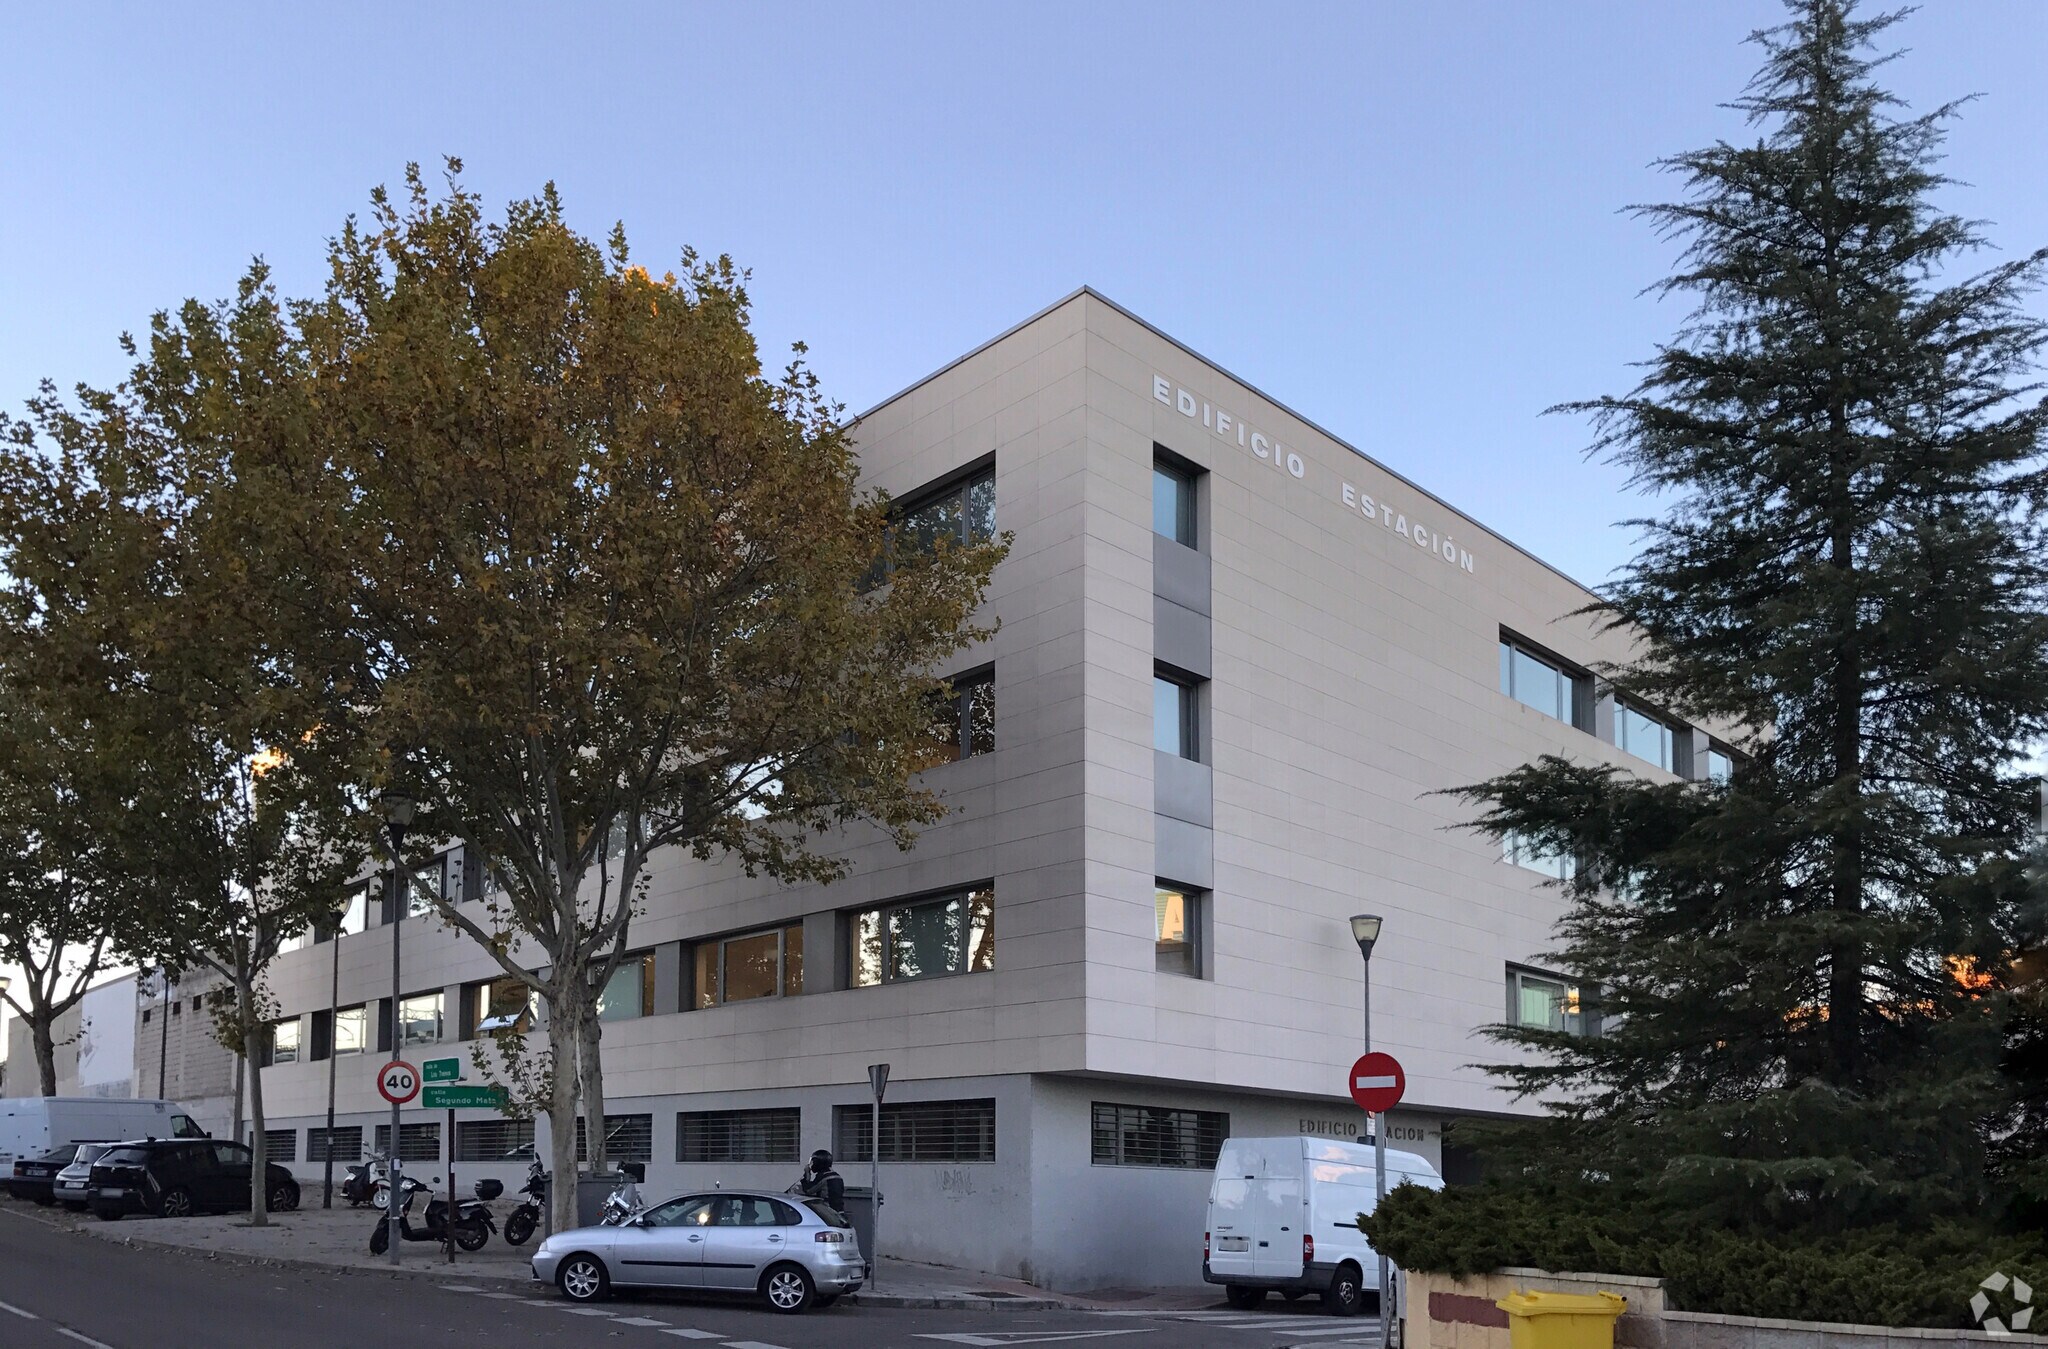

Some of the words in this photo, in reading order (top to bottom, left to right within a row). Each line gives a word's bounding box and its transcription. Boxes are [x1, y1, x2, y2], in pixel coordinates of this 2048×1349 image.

[1153, 374, 1305, 479] EDIFICIO
[1341, 482, 1474, 574] ESTACIÓN
[386, 1075, 412, 1089] 40
[435, 1096, 472, 1105] Segundo
[1299, 1119, 1357, 1136] EDIFICIO
[1385, 1126, 1424, 1142] ACION
